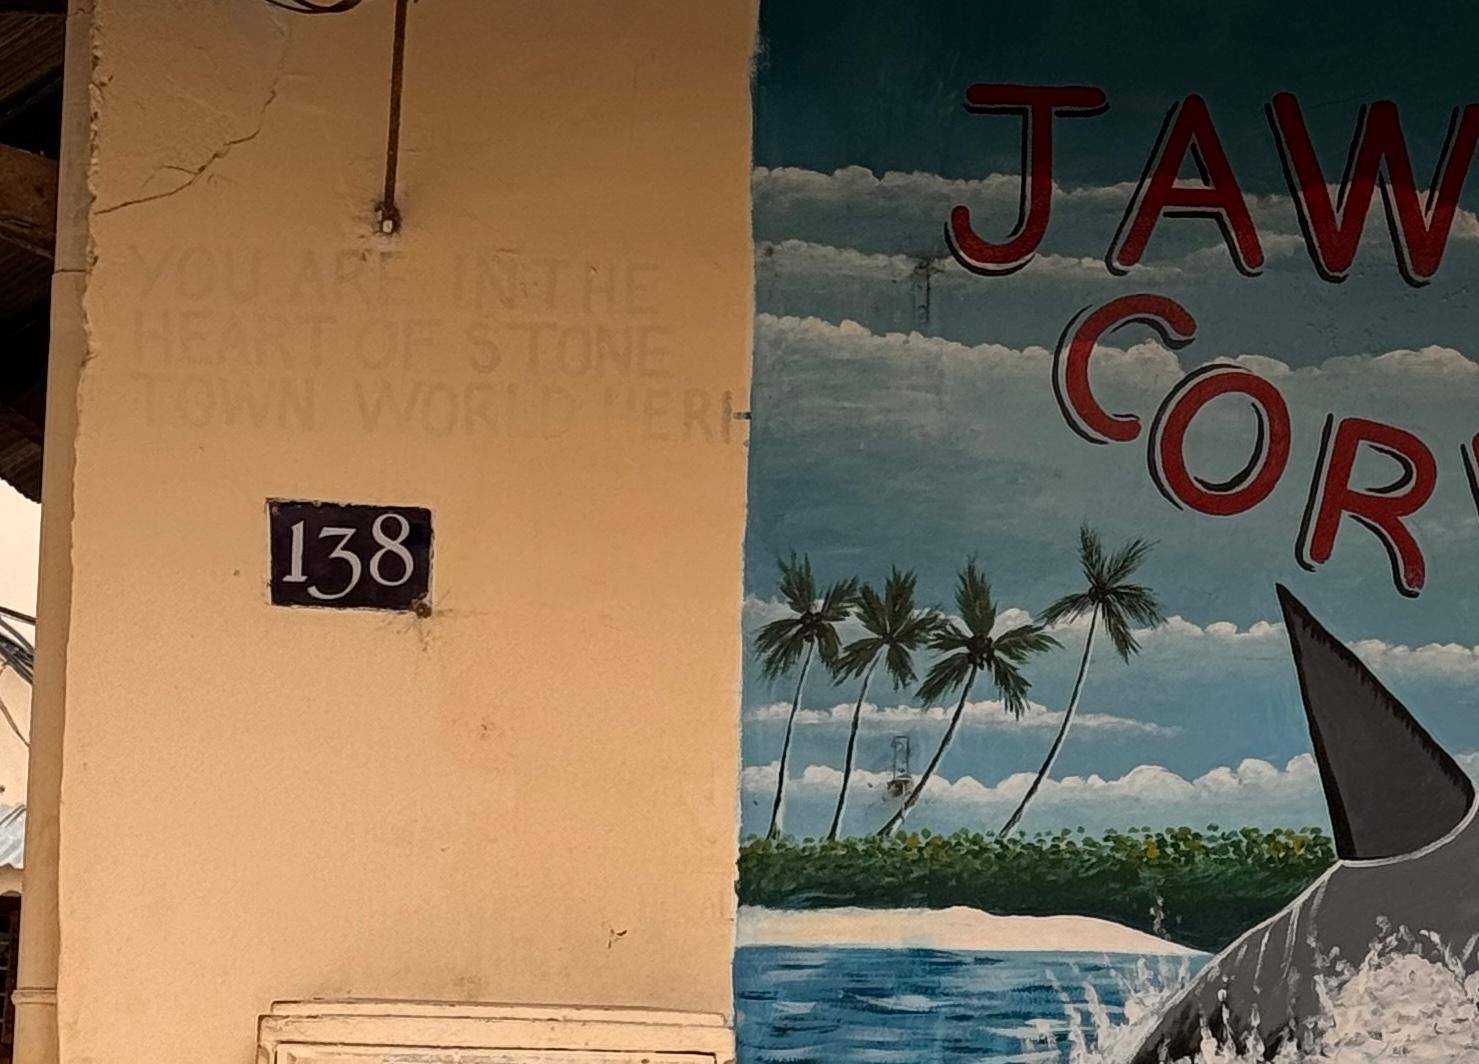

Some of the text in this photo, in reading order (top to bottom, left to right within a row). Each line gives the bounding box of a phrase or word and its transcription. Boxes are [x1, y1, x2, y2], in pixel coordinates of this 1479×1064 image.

[129, 244, 261, 303] YOU
[289, 247, 407, 309] ARE
[132, 308, 675, 380] HEART OF STONE
[129, 371, 315, 432] TOWN
[353, 377, 575, 440] WORLD
[282, 512, 415, 599] 138
